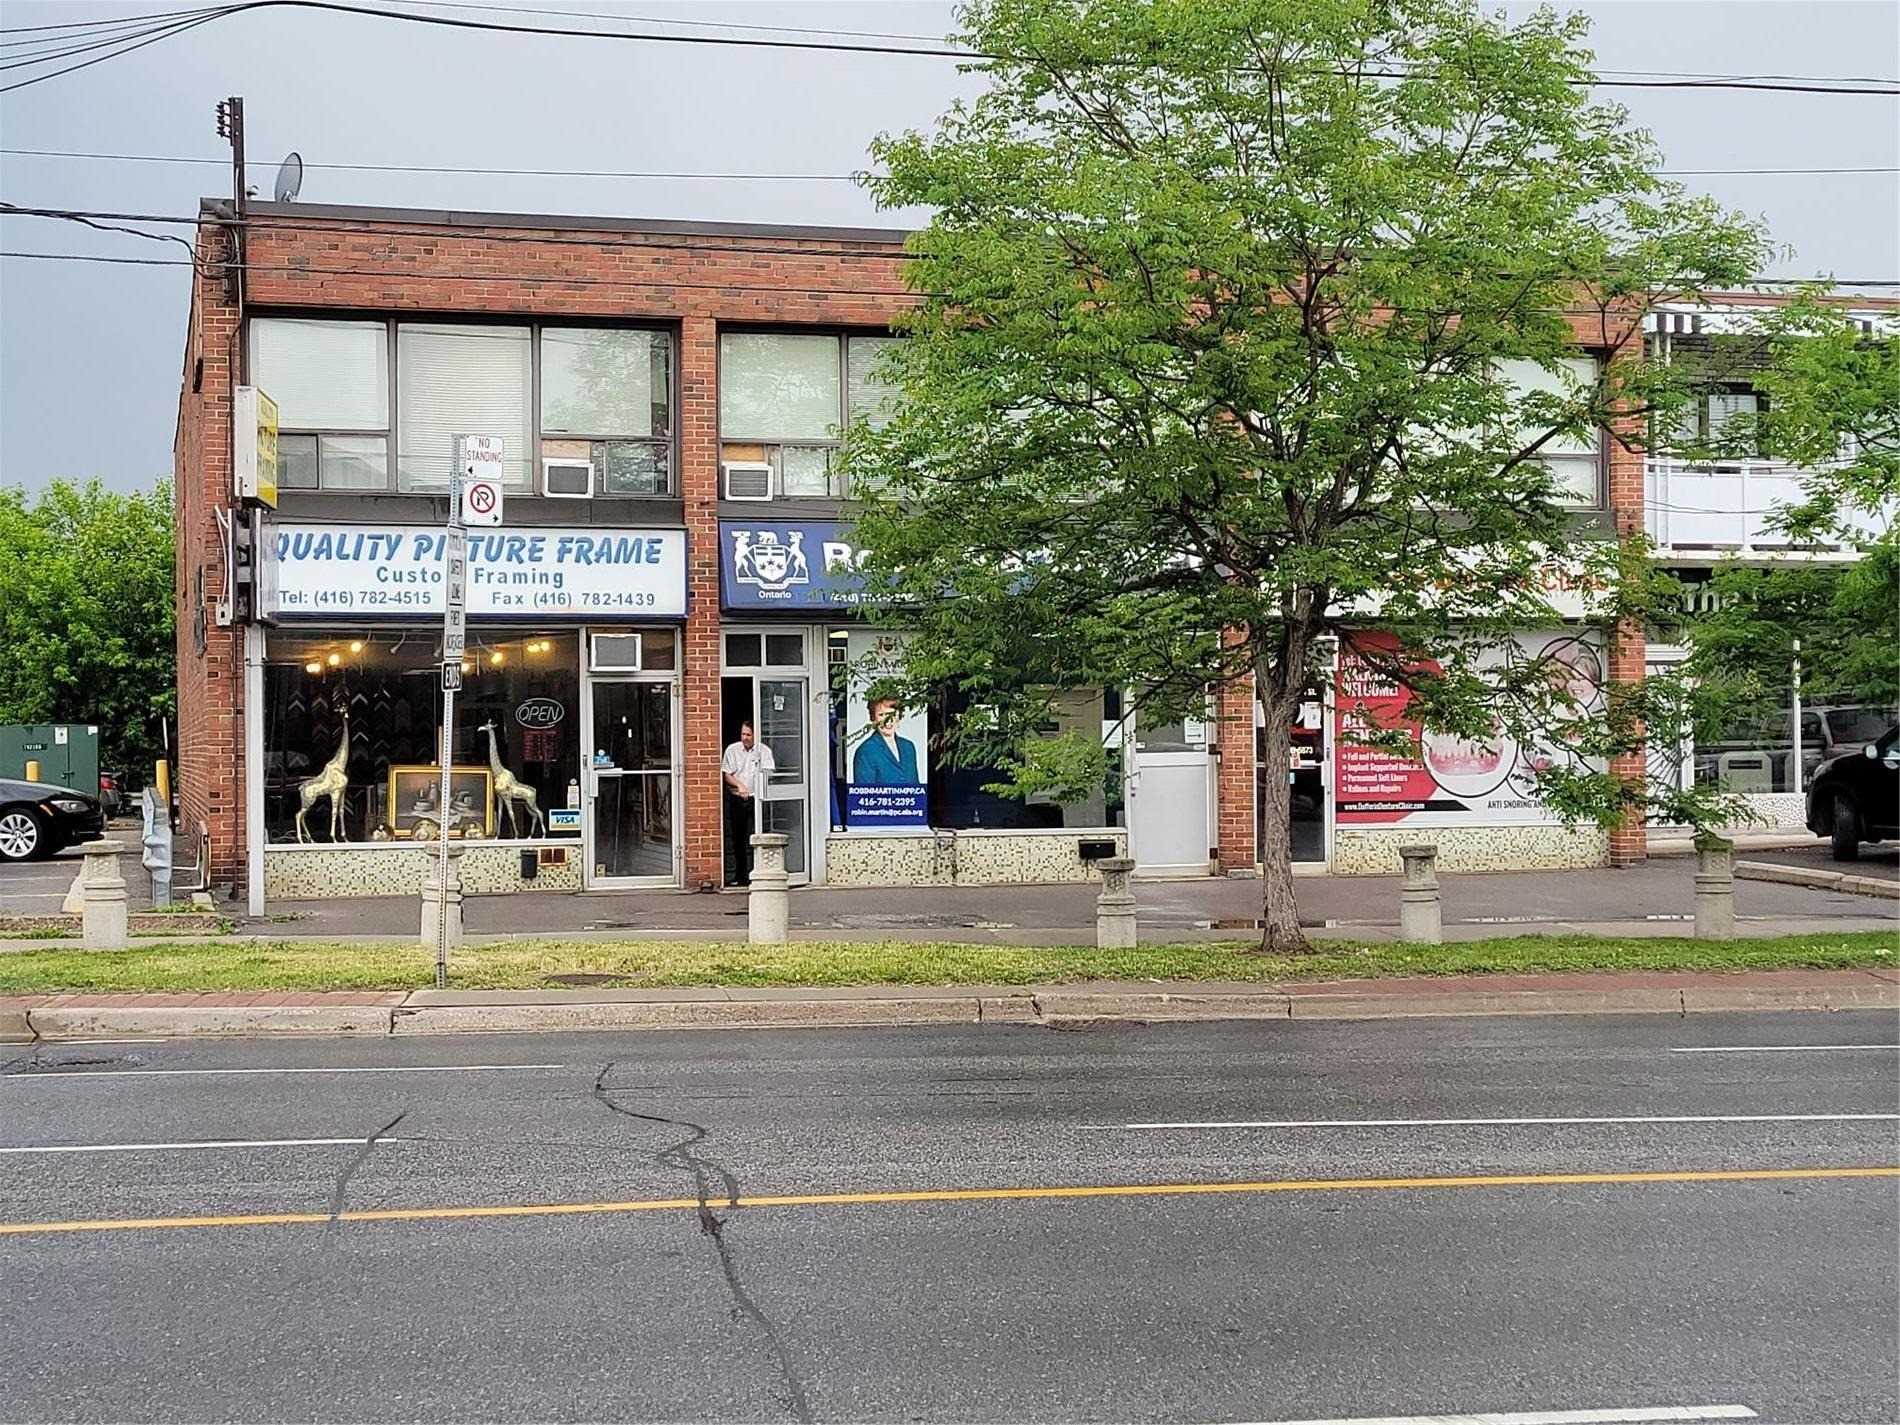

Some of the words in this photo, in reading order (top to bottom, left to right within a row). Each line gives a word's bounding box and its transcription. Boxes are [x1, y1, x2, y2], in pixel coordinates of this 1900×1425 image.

[478, 438, 491, 449] NO
[467, 449, 502, 463] STANDING
[277, 532, 404, 563] QUALITY
[413, 534, 546, 564] PITURE
[556, 536, 664, 566] FRAME
[376, 566, 442, 583] Custo
[474, 567, 564, 589] Framing
[280, 590, 308, 605] Tel:
[314, 590, 355, 608] (416)
[360, 591, 432, 606] 782-4515
[492, 591, 524, 606] Fax
[534, 592, 572, 609] (416)
[582, 592, 656, 607] 782-1439
[758, 590, 792, 600] Ontario
[518, 706, 560, 721] OPEN
[858, 797, 916, 806] 416-781-2395
[1487, 800, 1502, 809] ANTI
[1503, 799, 1532, 809] SNORING
[555, 815, 576, 824] VISA
